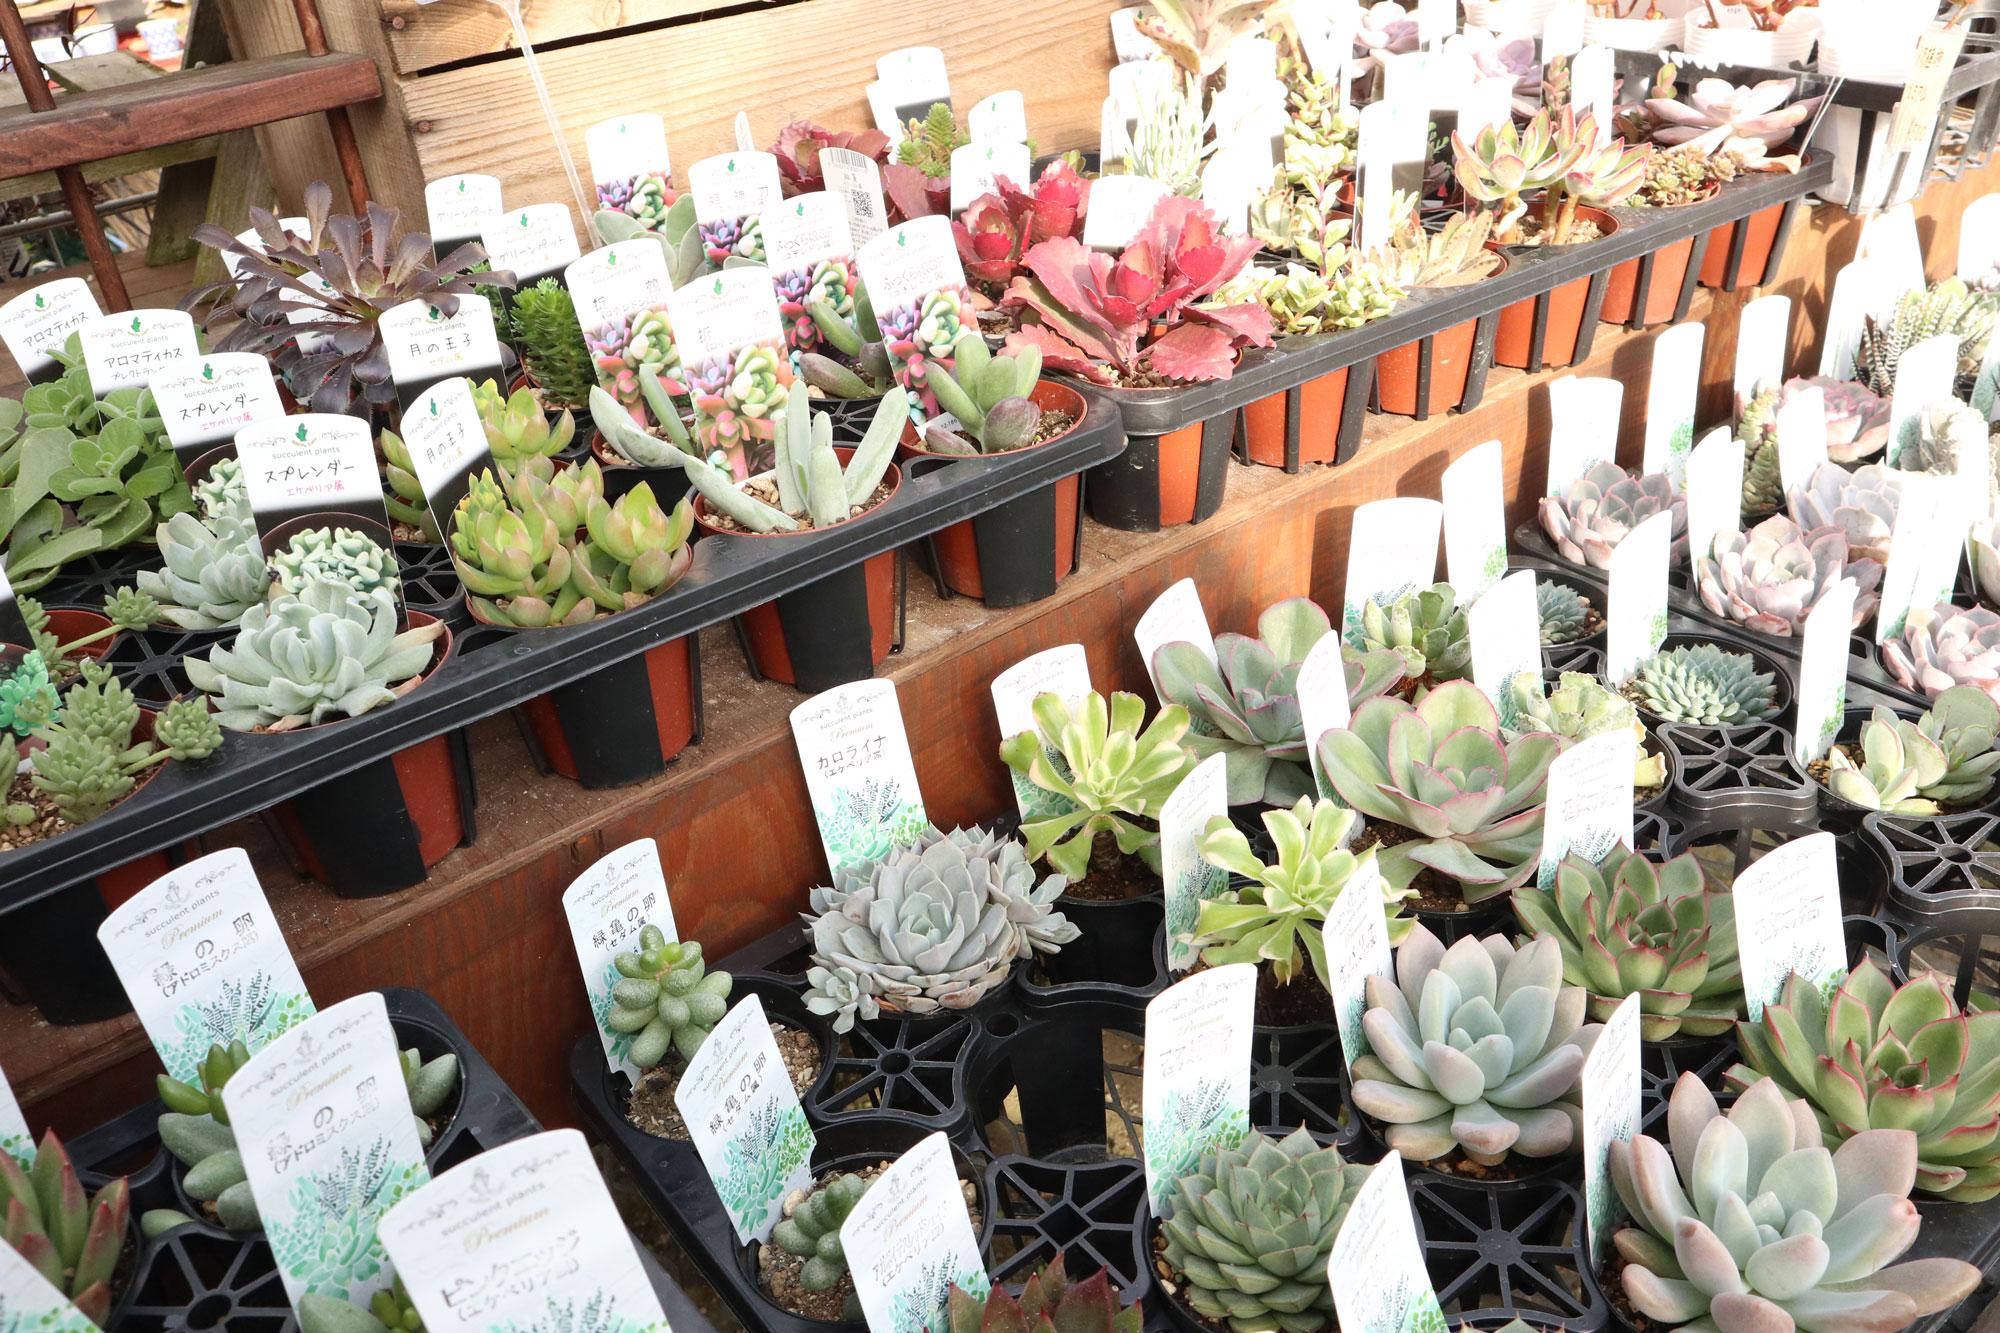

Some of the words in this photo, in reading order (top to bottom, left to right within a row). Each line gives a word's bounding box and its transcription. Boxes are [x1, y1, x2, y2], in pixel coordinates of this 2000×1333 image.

[23, 312, 89, 348] アロマティカス
[111, 339, 145, 349] succulent
[147, 335, 169, 346] plants
[410, 333, 473, 357] 月の王子
[104, 347, 186, 368] アロマティカス
[179, 392, 261, 421] スプレンダー
[184, 385, 219, 399] succulent
[221, 381, 245, 392] plants
[272, 448, 312, 460] succulent
[314, 444, 341, 457] plants
[426, 422, 465, 464] 月の王子
[264, 459, 355, 485] スプレンダー
[820, 714, 851, 730] succulent
[852, 707, 873, 722] plants
[817, 735, 887, 770] カロライナ
[144, 907, 190, 938] succulent
[191, 888, 220, 911] plants
[160, 908, 225, 951] Premium
[592, 892, 657, 949] 緑亀の卵
[270, 1061, 320, 1097] succulent
[321, 1041, 353, 1066] plants
[286, 1064, 354, 1112] Premium
[708, 1051, 767, 1136] 緑亀の卵
[441, 1201, 504, 1238] succulent
[505, 1181, 546, 1208] plants
[463, 1206, 552, 1255] Premium
